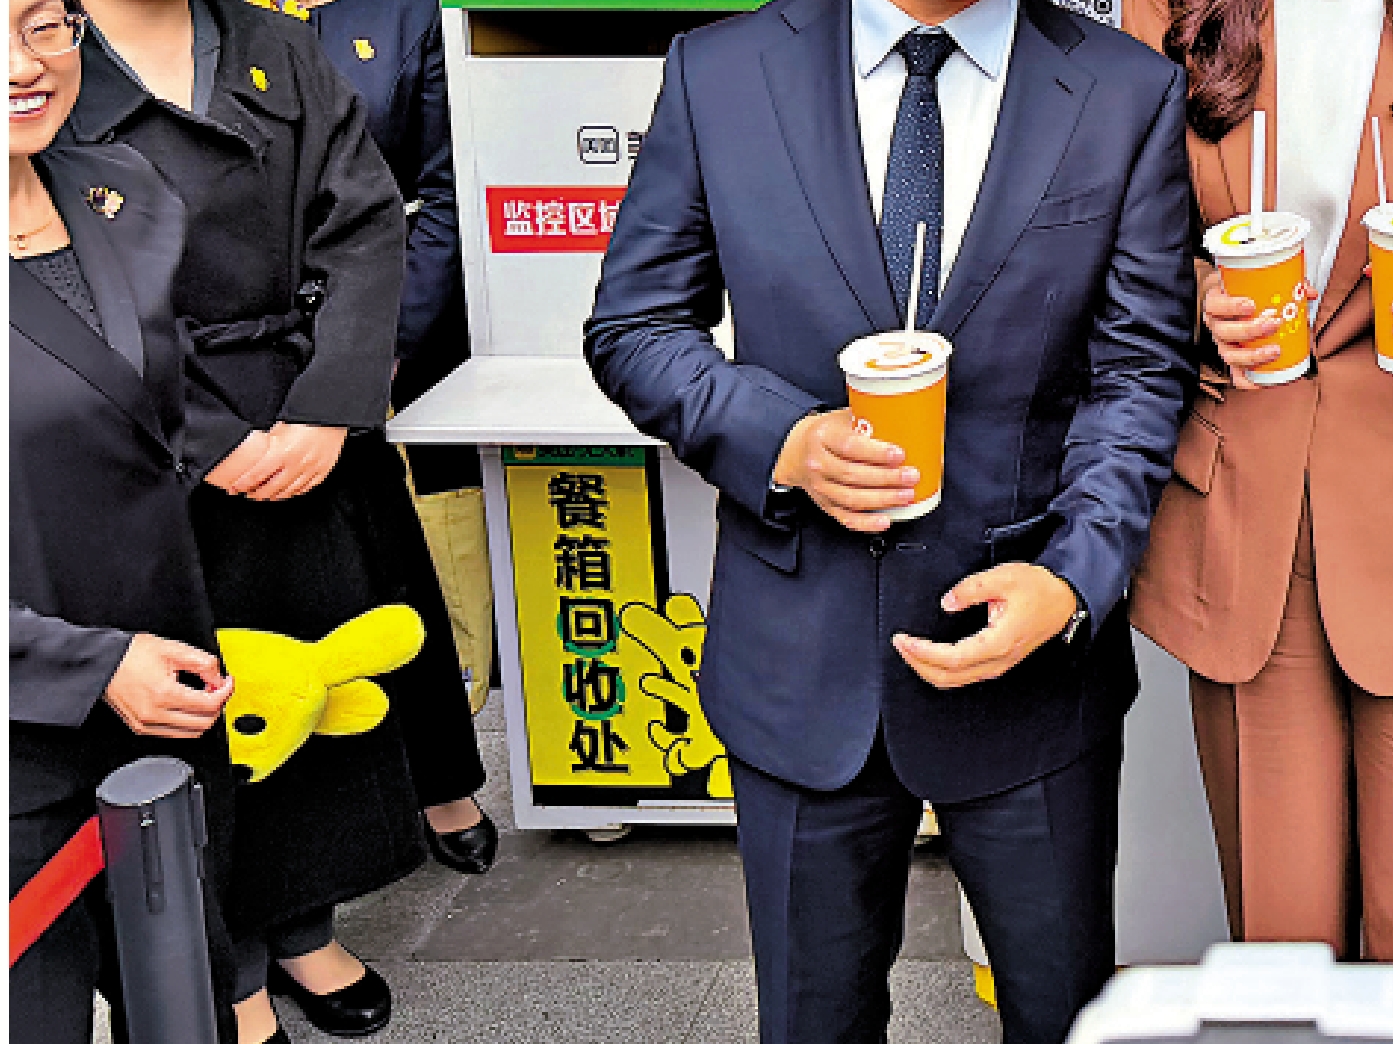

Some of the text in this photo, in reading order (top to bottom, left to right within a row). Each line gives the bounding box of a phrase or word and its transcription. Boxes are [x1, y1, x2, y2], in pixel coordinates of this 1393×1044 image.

[547, 471, 631, 774] 餐箱回收处
